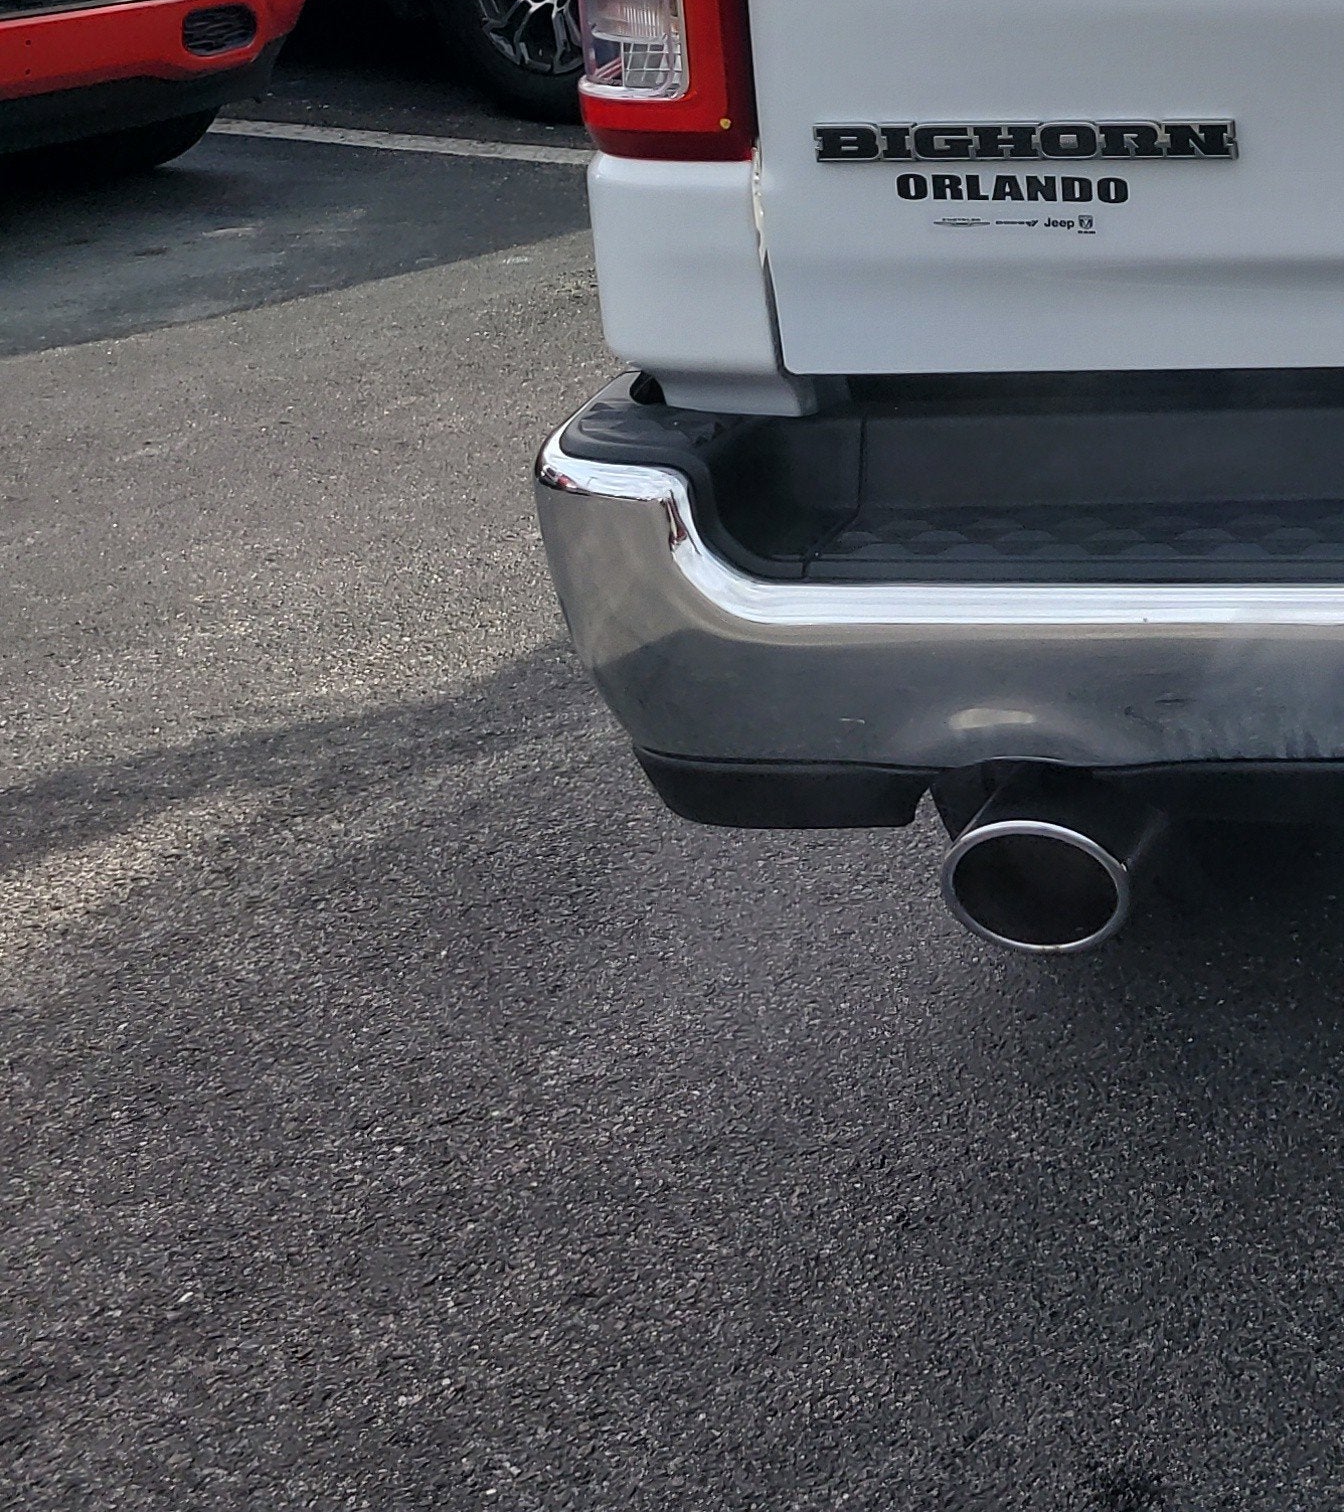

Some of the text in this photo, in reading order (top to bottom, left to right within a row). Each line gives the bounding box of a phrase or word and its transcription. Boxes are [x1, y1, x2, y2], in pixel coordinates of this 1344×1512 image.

[812, 118, 1238, 161] BIGHORN
[896, 173, 1129, 204] ORLANDO
[1043, 217, 1075, 230] Jeep
